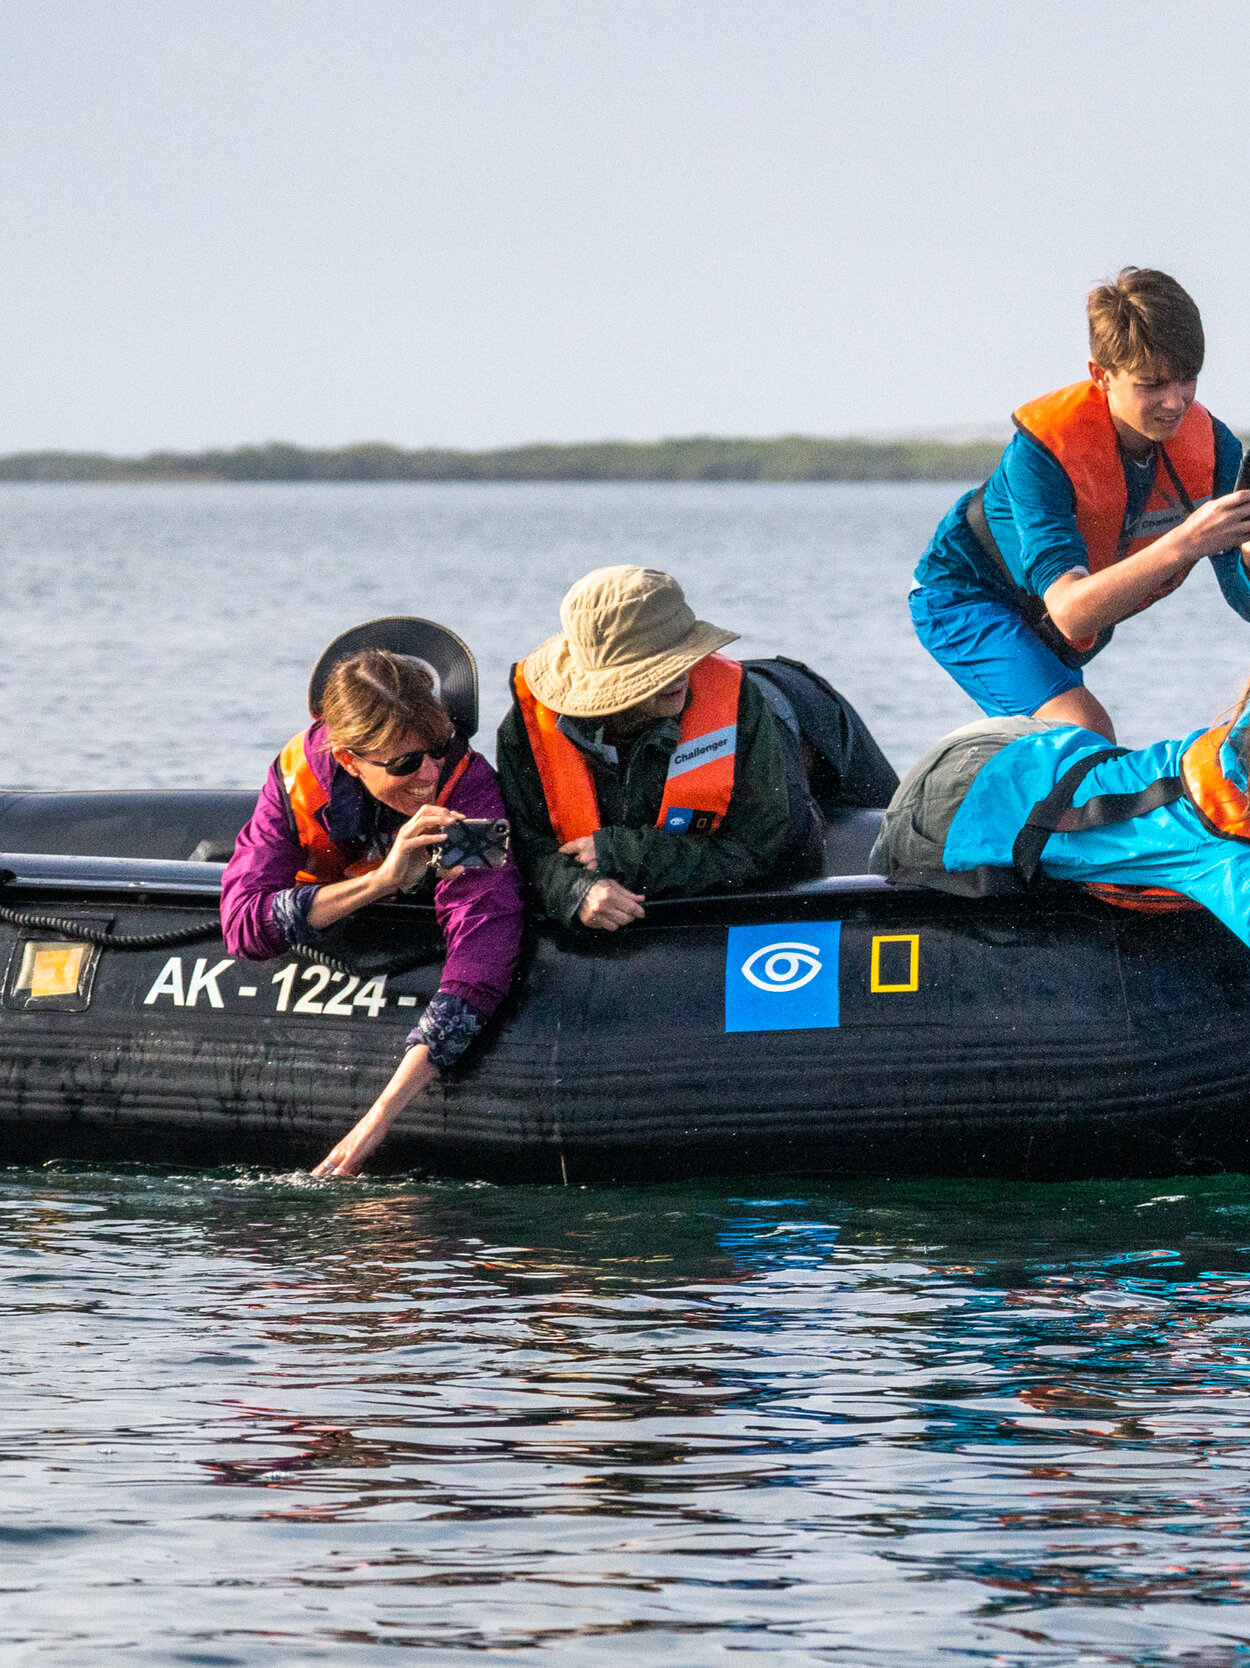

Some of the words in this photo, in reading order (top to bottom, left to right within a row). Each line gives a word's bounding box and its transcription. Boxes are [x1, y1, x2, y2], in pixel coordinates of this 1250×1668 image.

[674, 739, 728, 764] Challenger
[143, 957, 235, 1008] AK
[271, 963, 388, 1018] 1224
